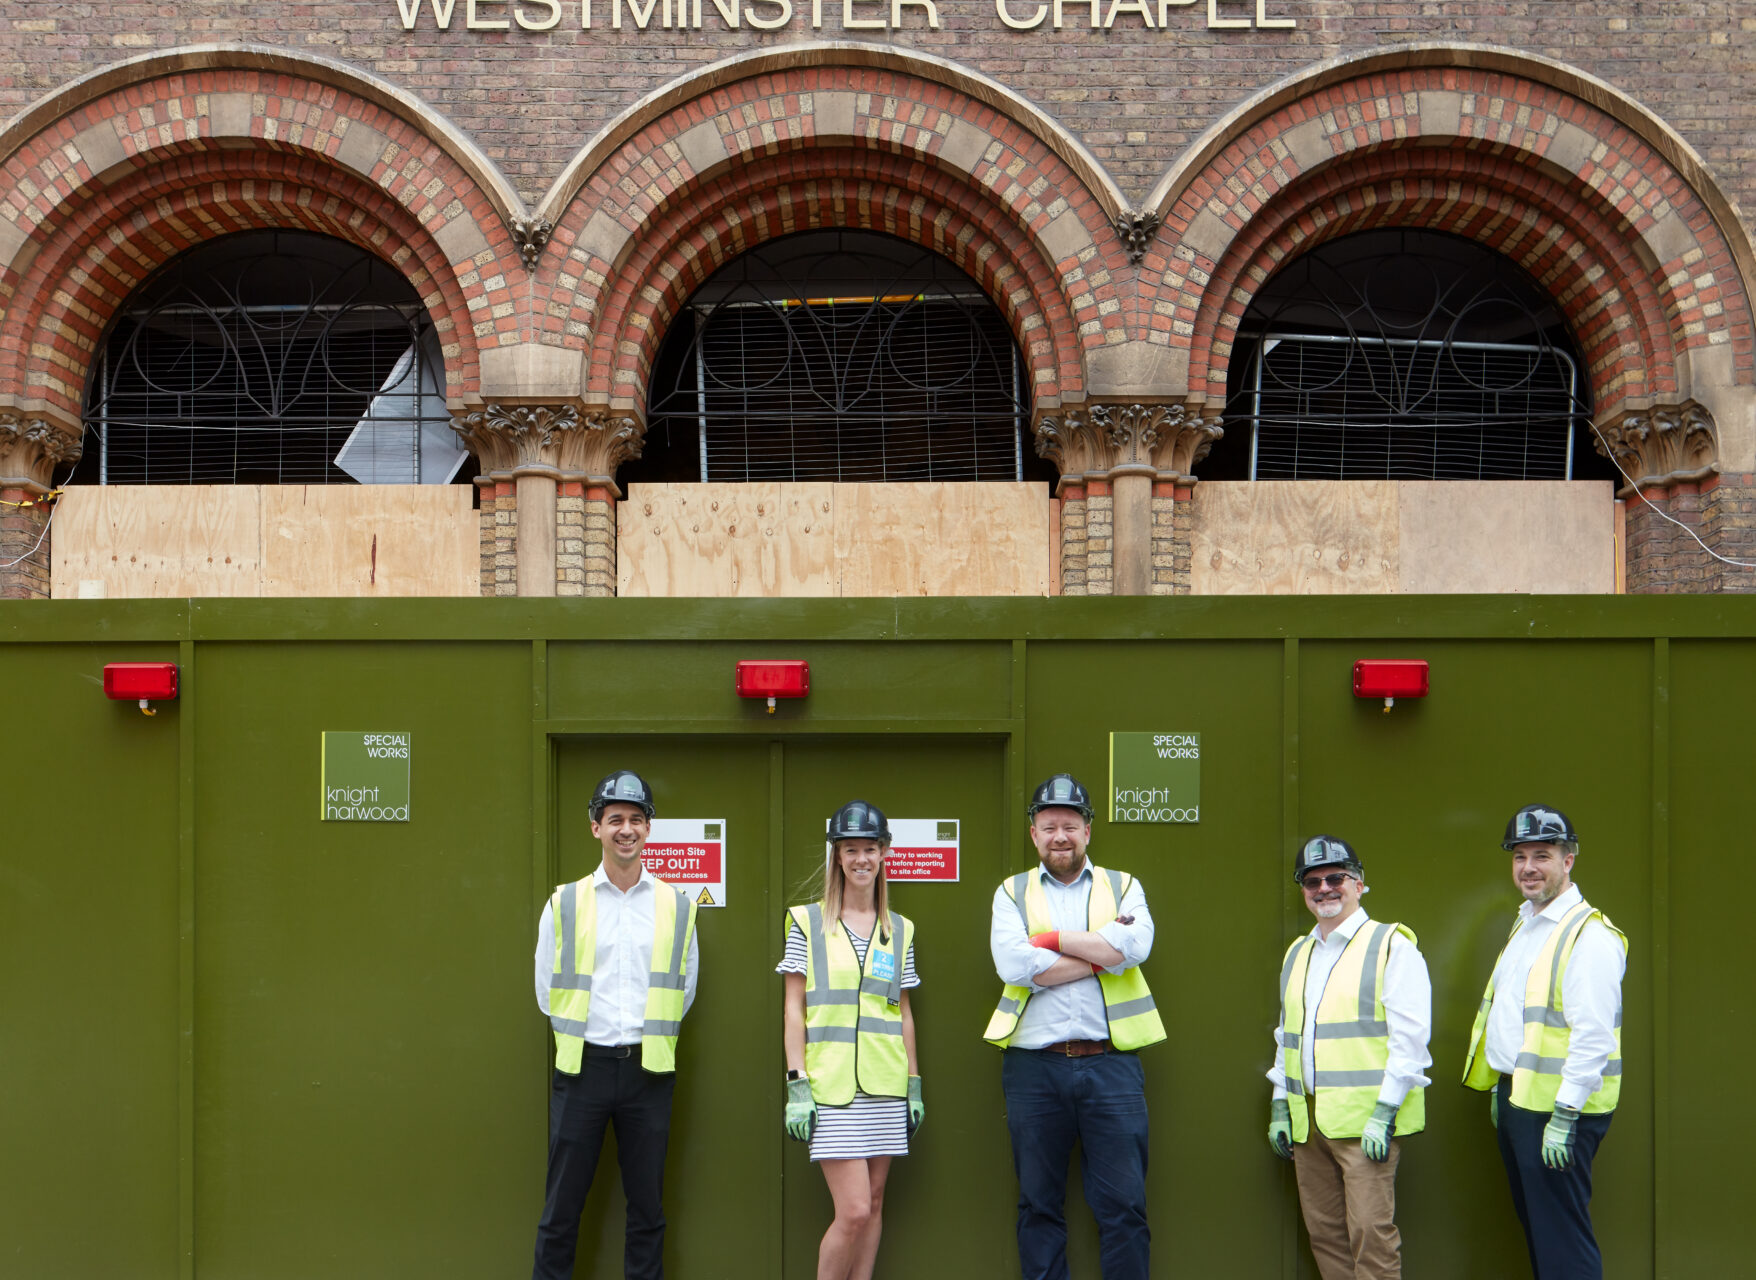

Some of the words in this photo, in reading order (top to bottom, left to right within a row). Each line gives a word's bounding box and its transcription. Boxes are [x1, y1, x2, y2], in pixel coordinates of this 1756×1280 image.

[363, 734, 408, 746] SPECIAL
[1153, 735, 1198, 746] SPECIAL
[367, 747, 409, 759] WORKS
[1156, 747, 1199, 759] WORKS
[327, 785, 379, 806] knight
[1115, 787, 1169, 807] knight
[327, 803, 408, 820] harwood
[1115, 805, 1199, 822] harwood
[640, 847, 685, 856] struction
[687, 847, 706, 856] Site
[916, 852, 943, 860] working
[640, 858, 665, 870] EEP
[667, 858, 700, 870] OUT!
[915, 860, 945, 868] reporting
